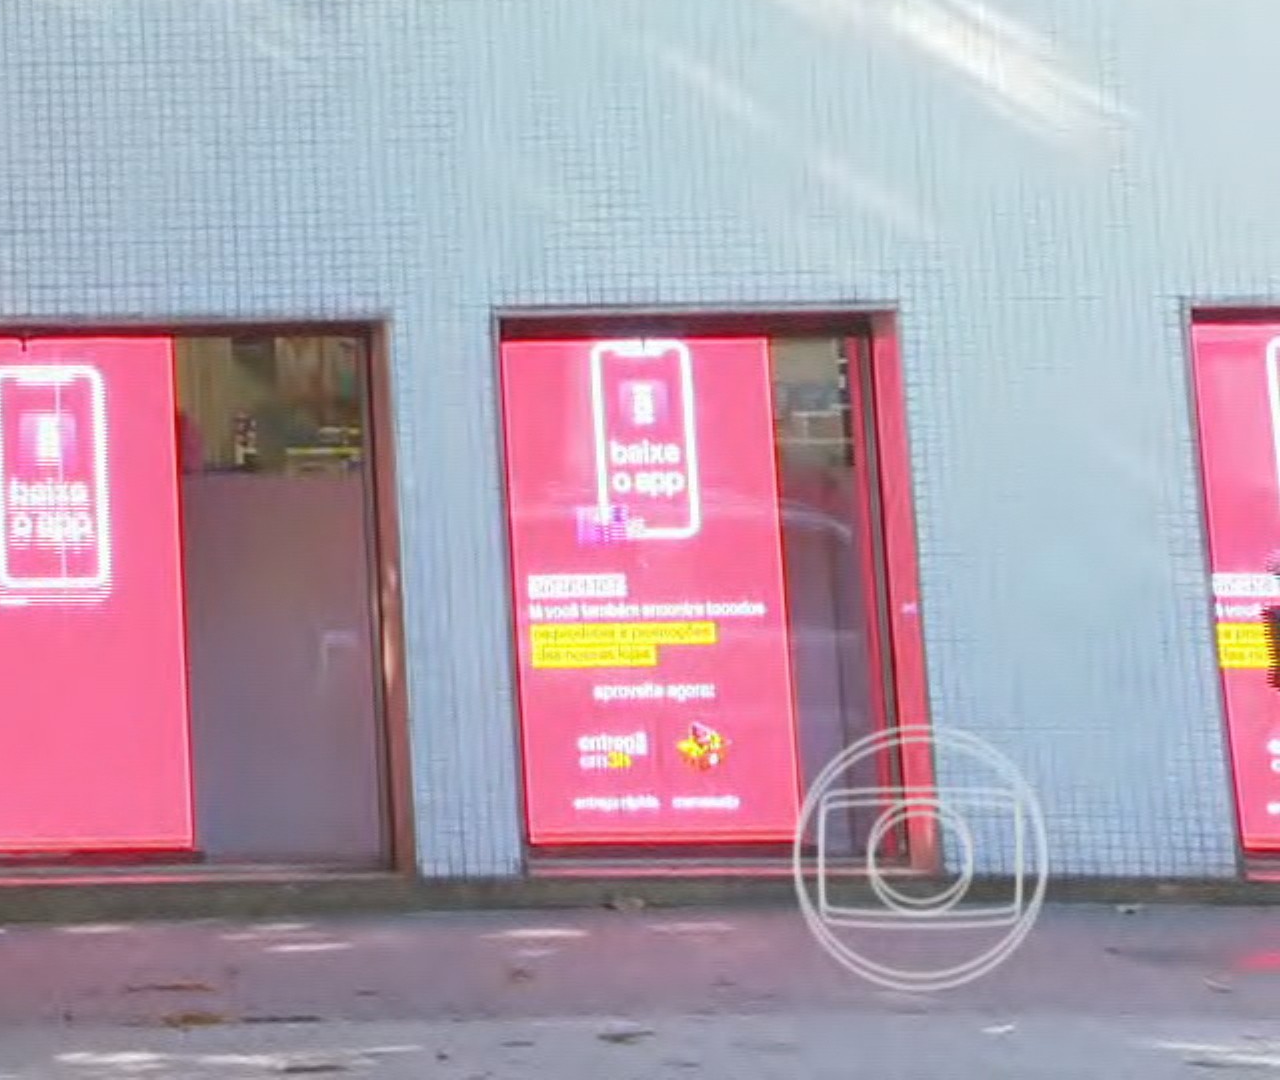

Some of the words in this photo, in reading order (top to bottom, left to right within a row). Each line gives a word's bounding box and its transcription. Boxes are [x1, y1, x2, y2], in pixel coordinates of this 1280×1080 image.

[610, 438, 680, 466] baixe
[9, 477, 89, 507] baixe
[612, 471, 632, 493] o
[635, 471, 685, 497] app
[9, 512, 32, 542] o
[35, 512, 96, 548] app
